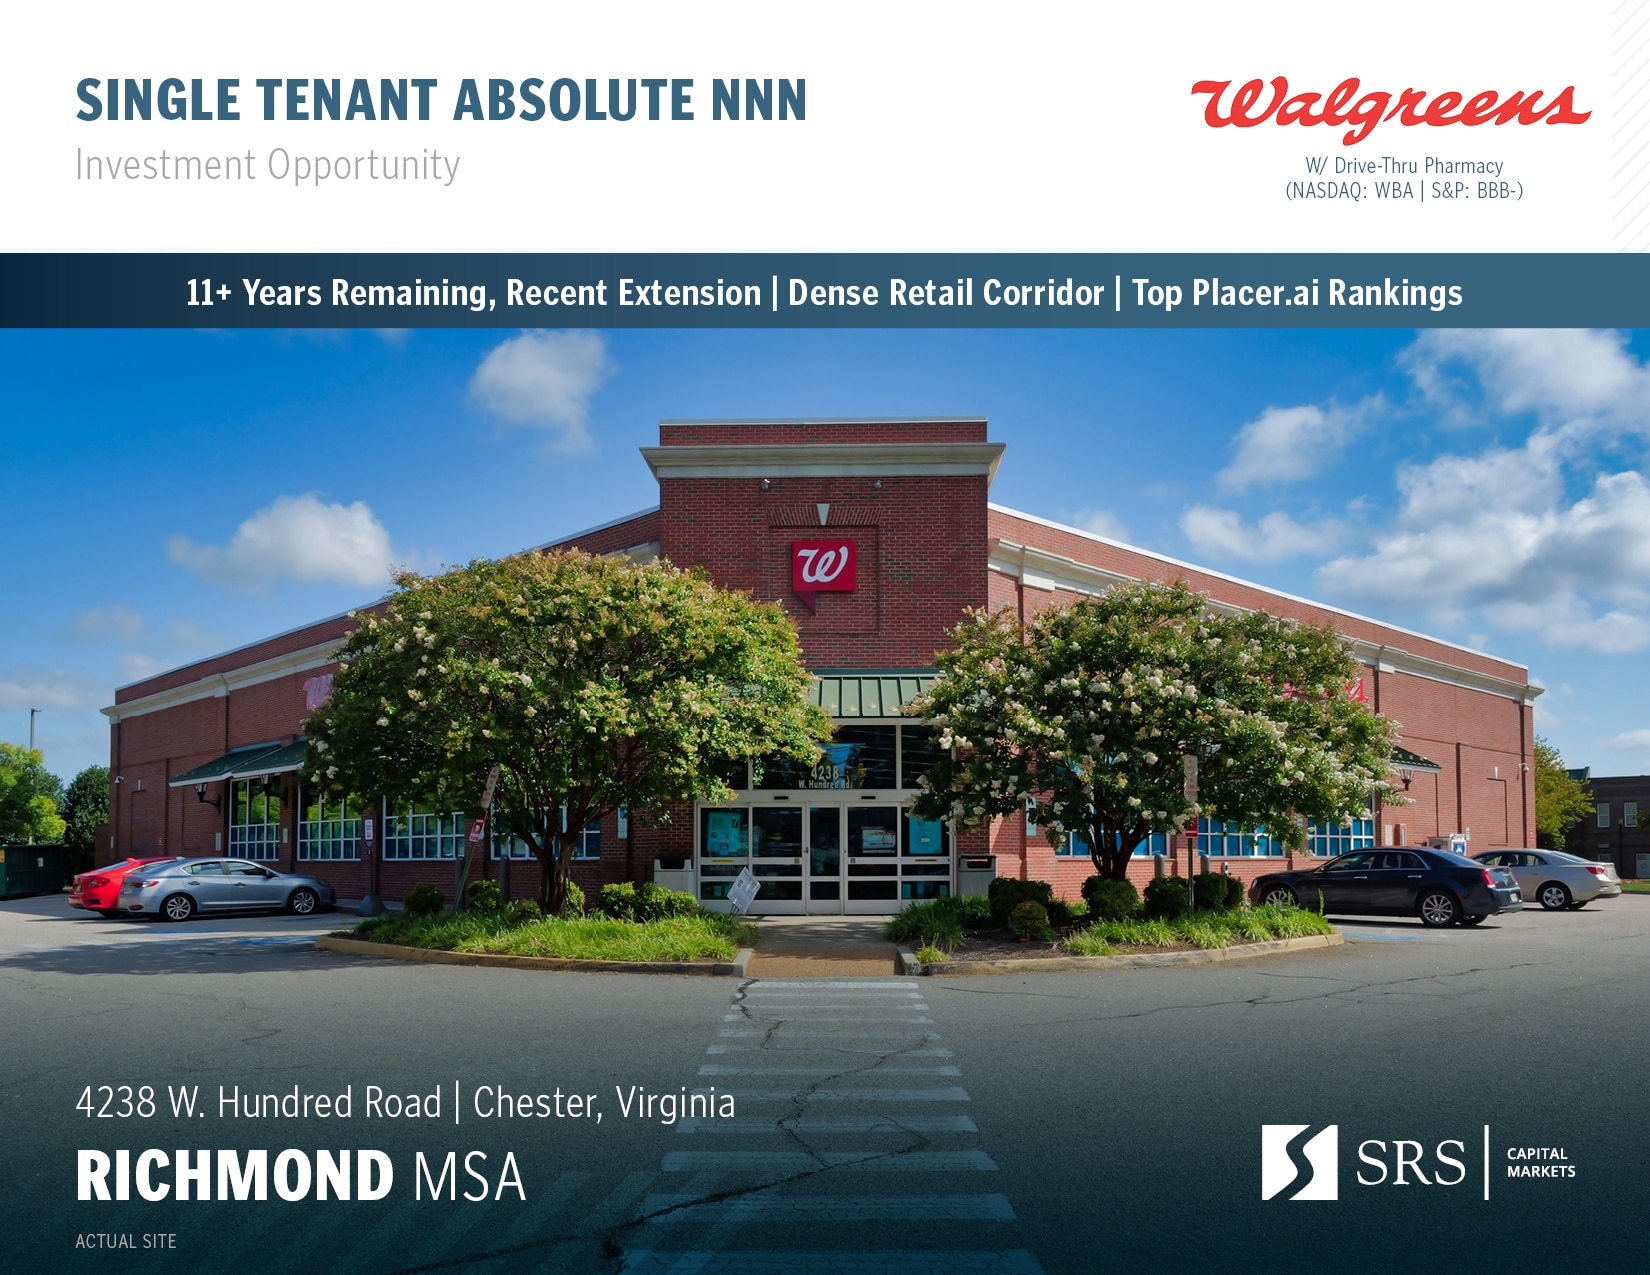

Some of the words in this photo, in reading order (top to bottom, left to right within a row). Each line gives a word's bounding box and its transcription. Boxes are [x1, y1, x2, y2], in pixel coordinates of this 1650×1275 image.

[811, 765, 839, 780] 4238
[799, 780, 807, 789] W.
[808, 780, 839, 789] Hundred
